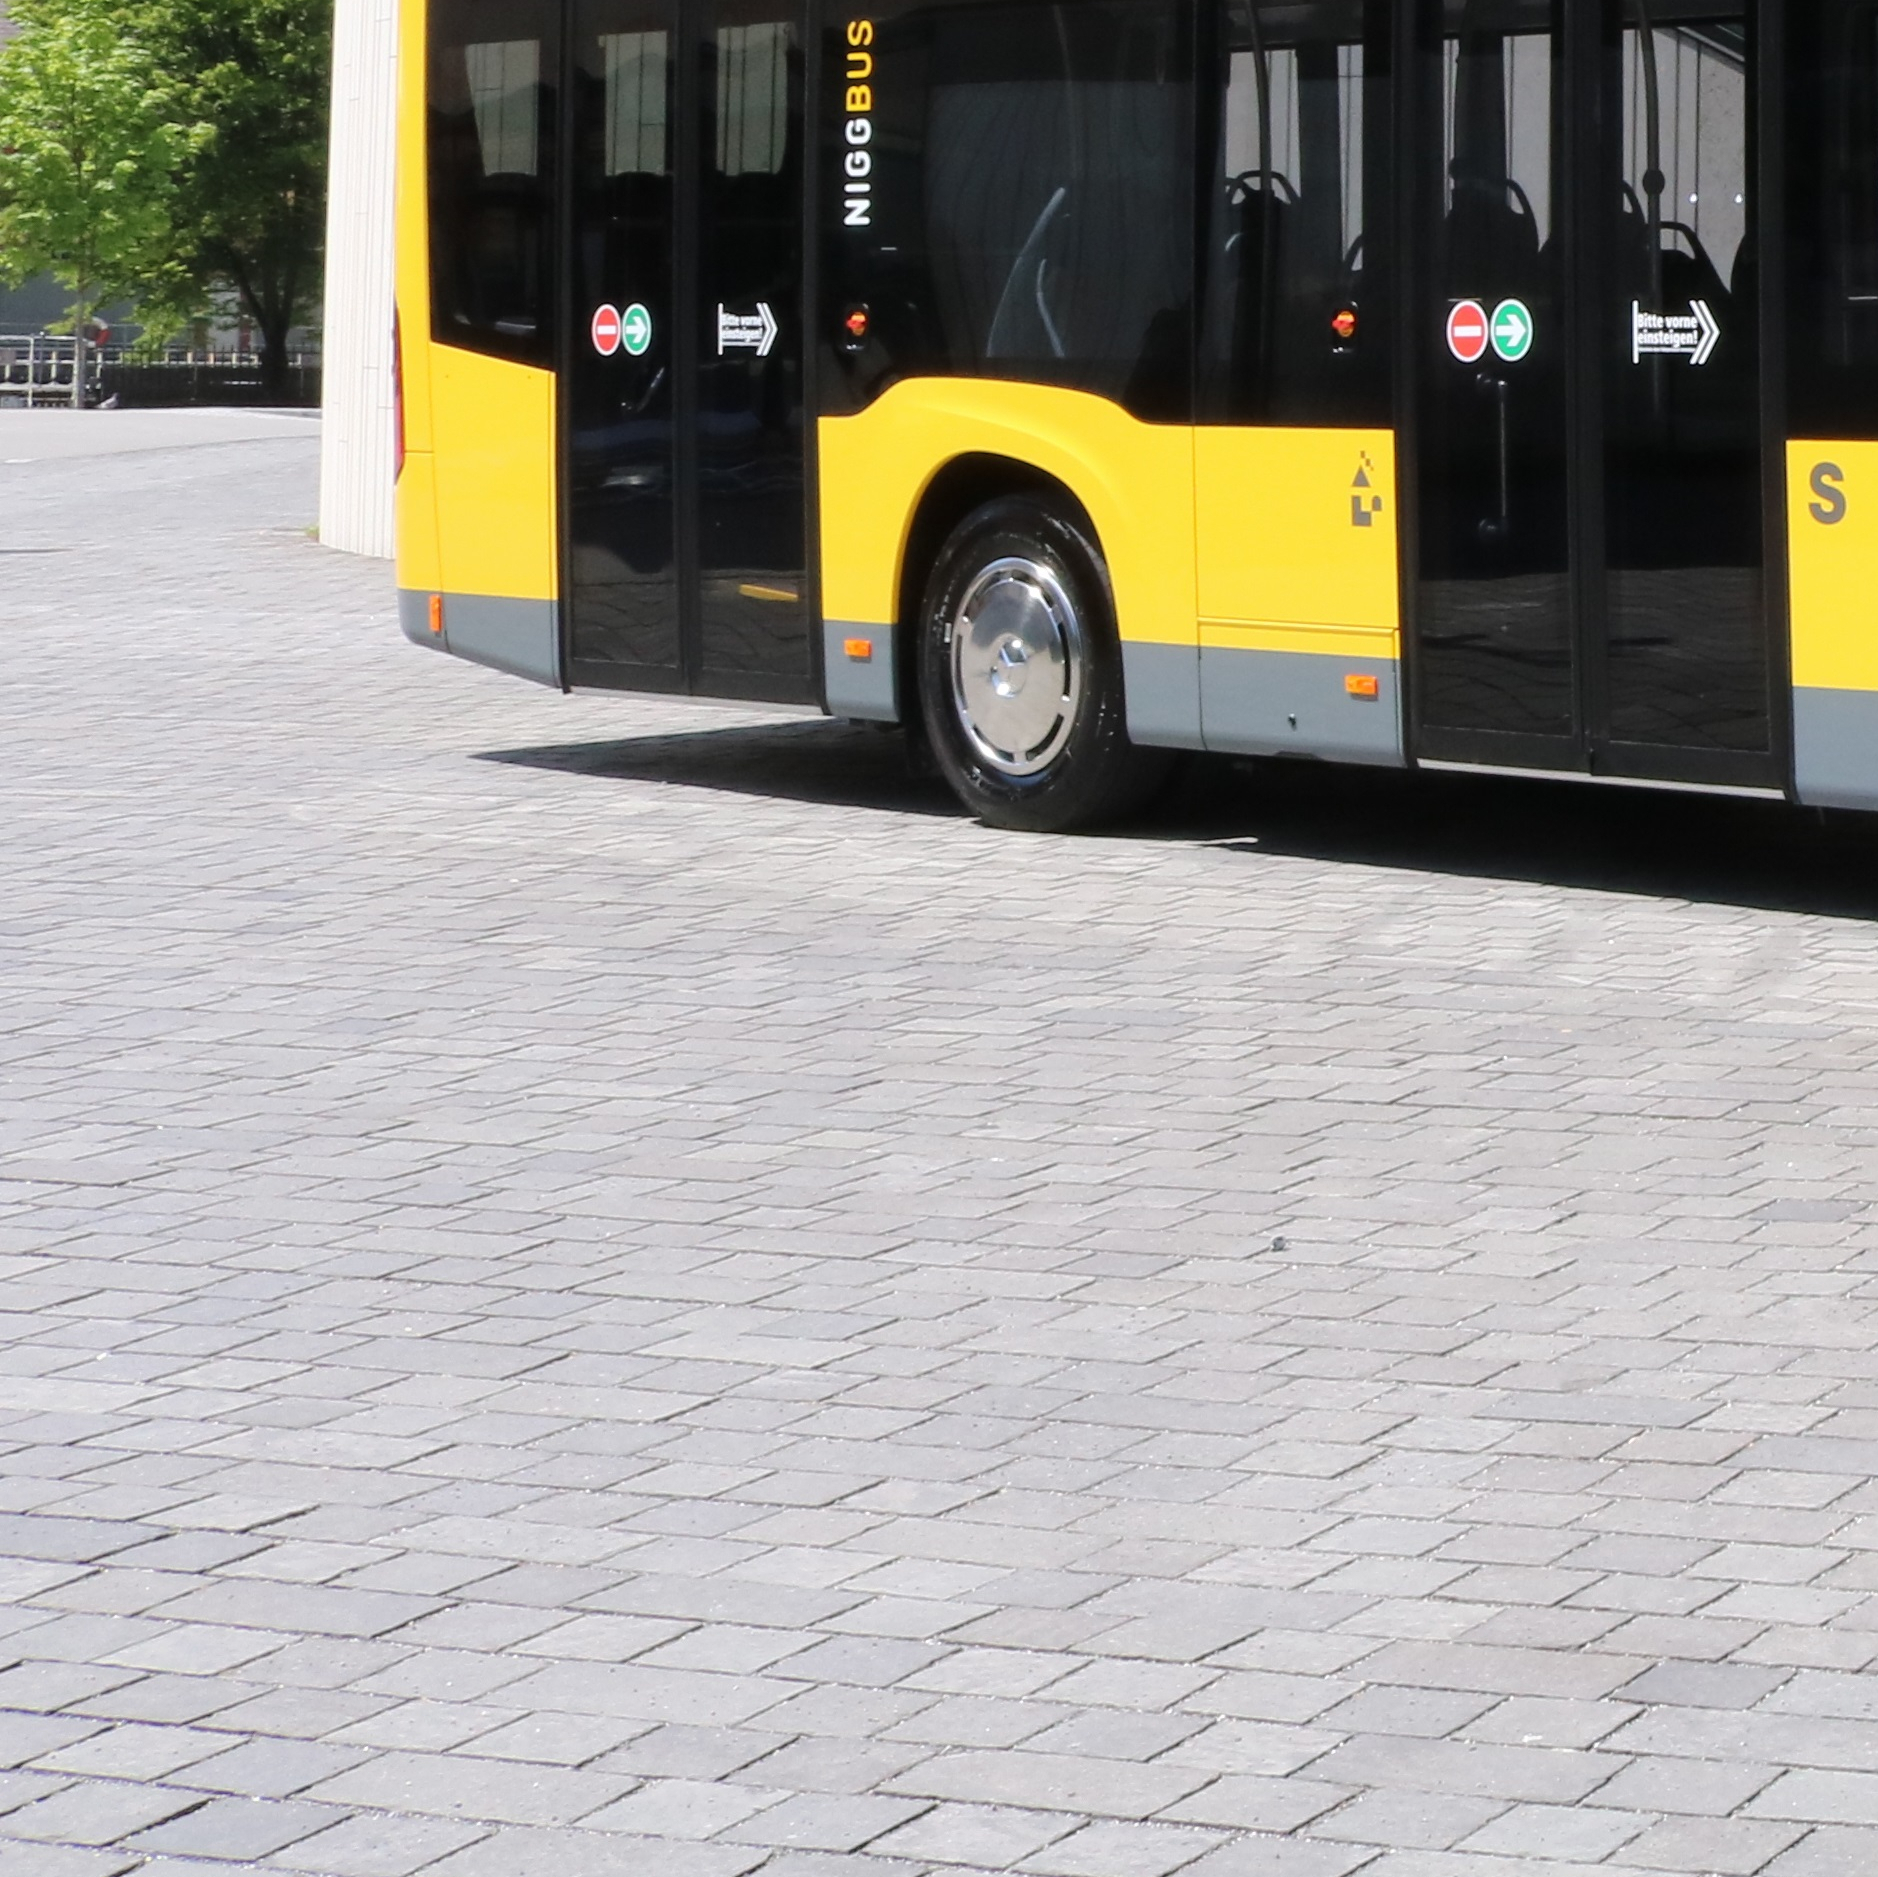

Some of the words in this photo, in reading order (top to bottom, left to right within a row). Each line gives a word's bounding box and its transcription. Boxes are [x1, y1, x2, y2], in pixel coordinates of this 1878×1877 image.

[844, 18, 875, 226] NIGGBUS
[1638, 312, 1664, 328] Bitte
[1665, 315, 1698, 329] vorne
[1638, 329, 1699, 348] einsteigen!
